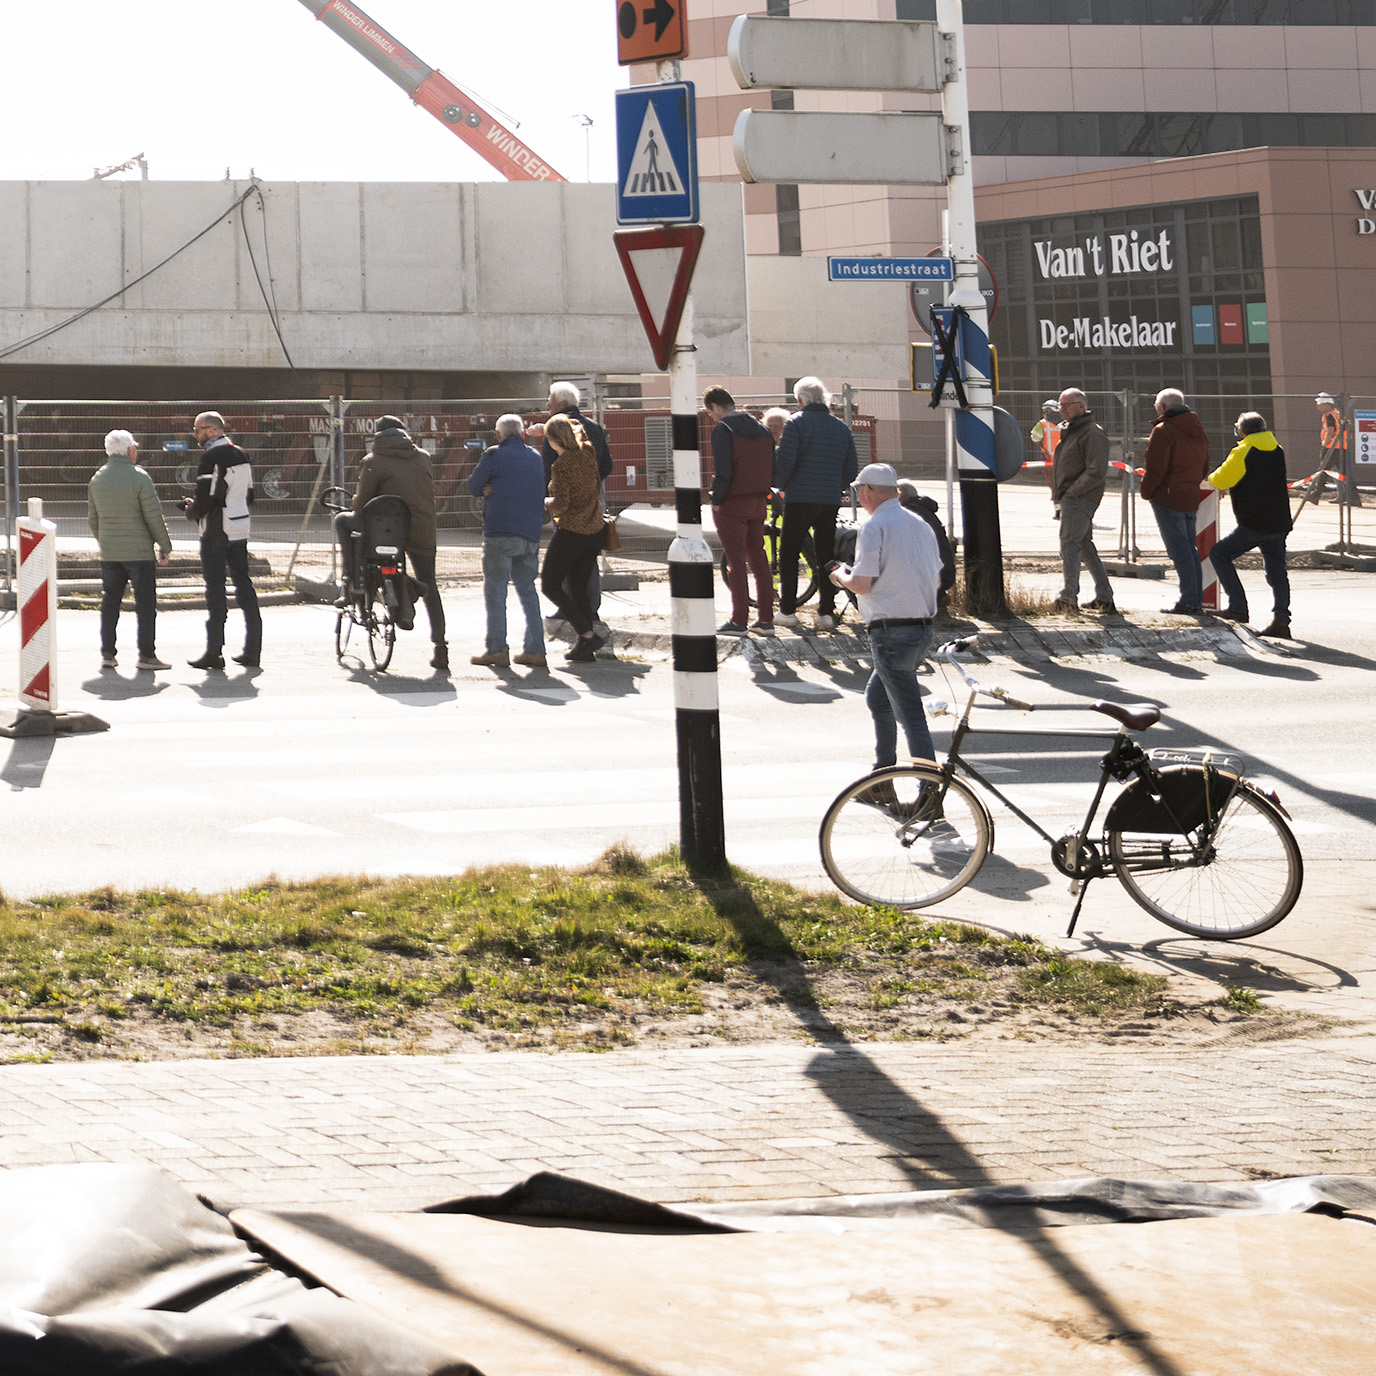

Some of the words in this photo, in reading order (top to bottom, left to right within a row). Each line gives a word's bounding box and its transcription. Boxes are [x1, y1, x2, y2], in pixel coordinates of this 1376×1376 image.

[332, 0, 364, 29] WINDER
[361, 23, 395, 53] LIMMEN
[485, 124, 550, 181] WINDER
[837, 263, 946, 275] Industriestraat
[1109, 229, 1173, 274] Riet
[1039, 315, 1176, 349] De-Makelaar
